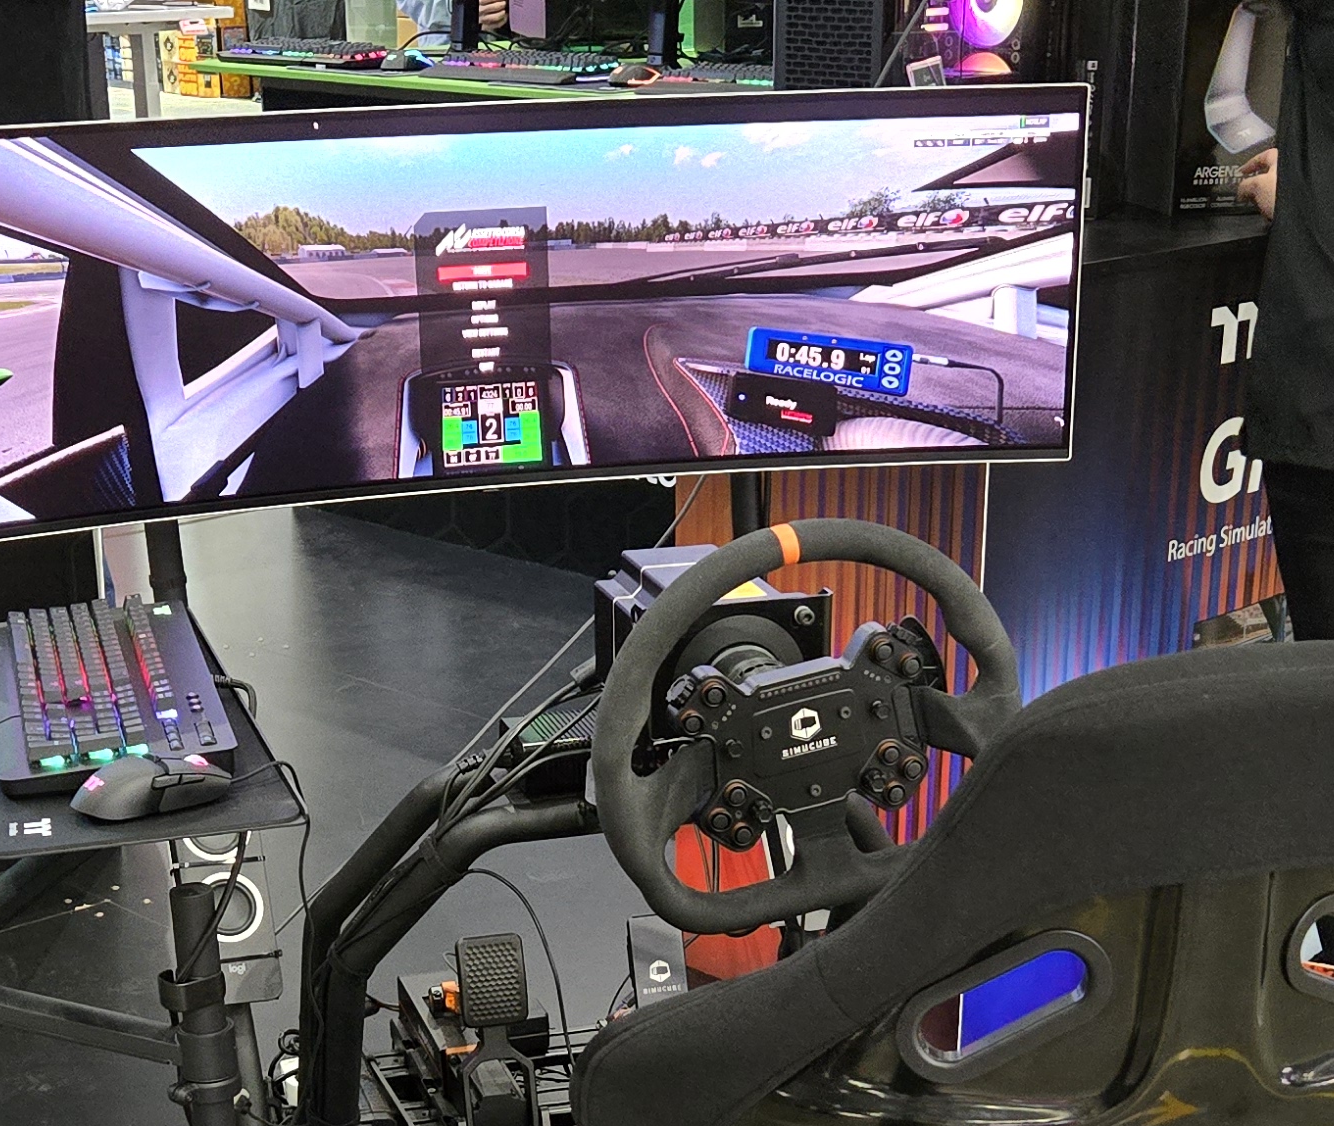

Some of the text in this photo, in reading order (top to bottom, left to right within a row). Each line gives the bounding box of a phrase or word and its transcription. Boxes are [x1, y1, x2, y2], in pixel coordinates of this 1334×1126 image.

[897, 211, 941, 227] elf
[998, 203, 1067, 223] elf
[776, 222, 801, 234] elf
[827, 217, 859, 231] elf
[776, 342, 845, 371] 0:45.9
[859, 352, 876, 363] Lap
[774, 364, 864, 388] RACELOGIC
[766, 395, 797, 411] Ready
[485, 418, 498, 440] 2
[1168, 515, 1273, 563] Racing Simulat
[782, 736, 837, 757] SIMUCUBE
[228, 962, 246, 975] logi
